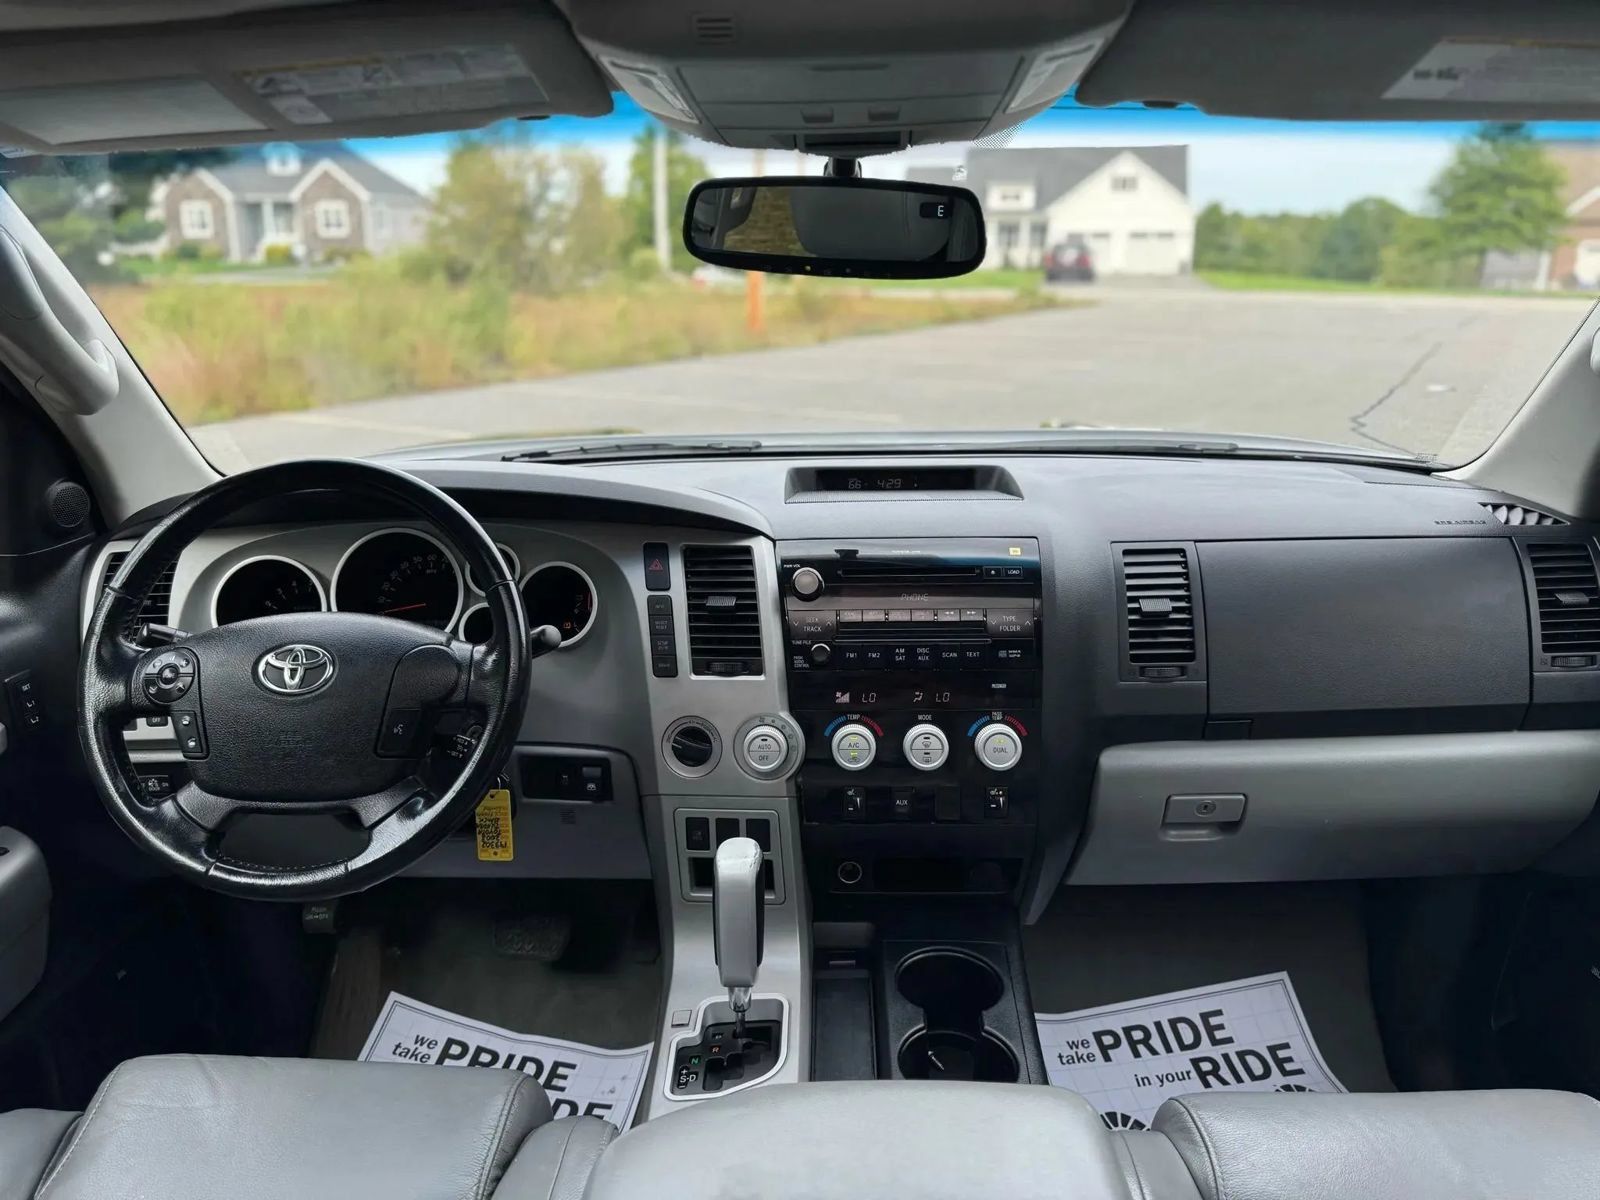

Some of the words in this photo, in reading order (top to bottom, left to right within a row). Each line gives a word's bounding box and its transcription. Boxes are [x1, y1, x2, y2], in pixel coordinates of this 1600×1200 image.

[937, 205, 945, 217] E
[900, 592, 929, 601] PHONE
[861, 692, 877, 703] LO
[935, 692, 951, 703] LO
[848, 741, 860, 749] A/C
[413, 1033, 438, 1050] we
[1066, 1038, 1091, 1050] we
[1092, 1009, 1235, 1063] PRIDE
[391, 1042, 431, 1064] take
[1057, 1050, 1096, 1066] take
[1134, 1074, 1152, 1088] in
[1155, 1067, 1192, 1088] your
[1189, 1042, 1306, 1089] RIDE
